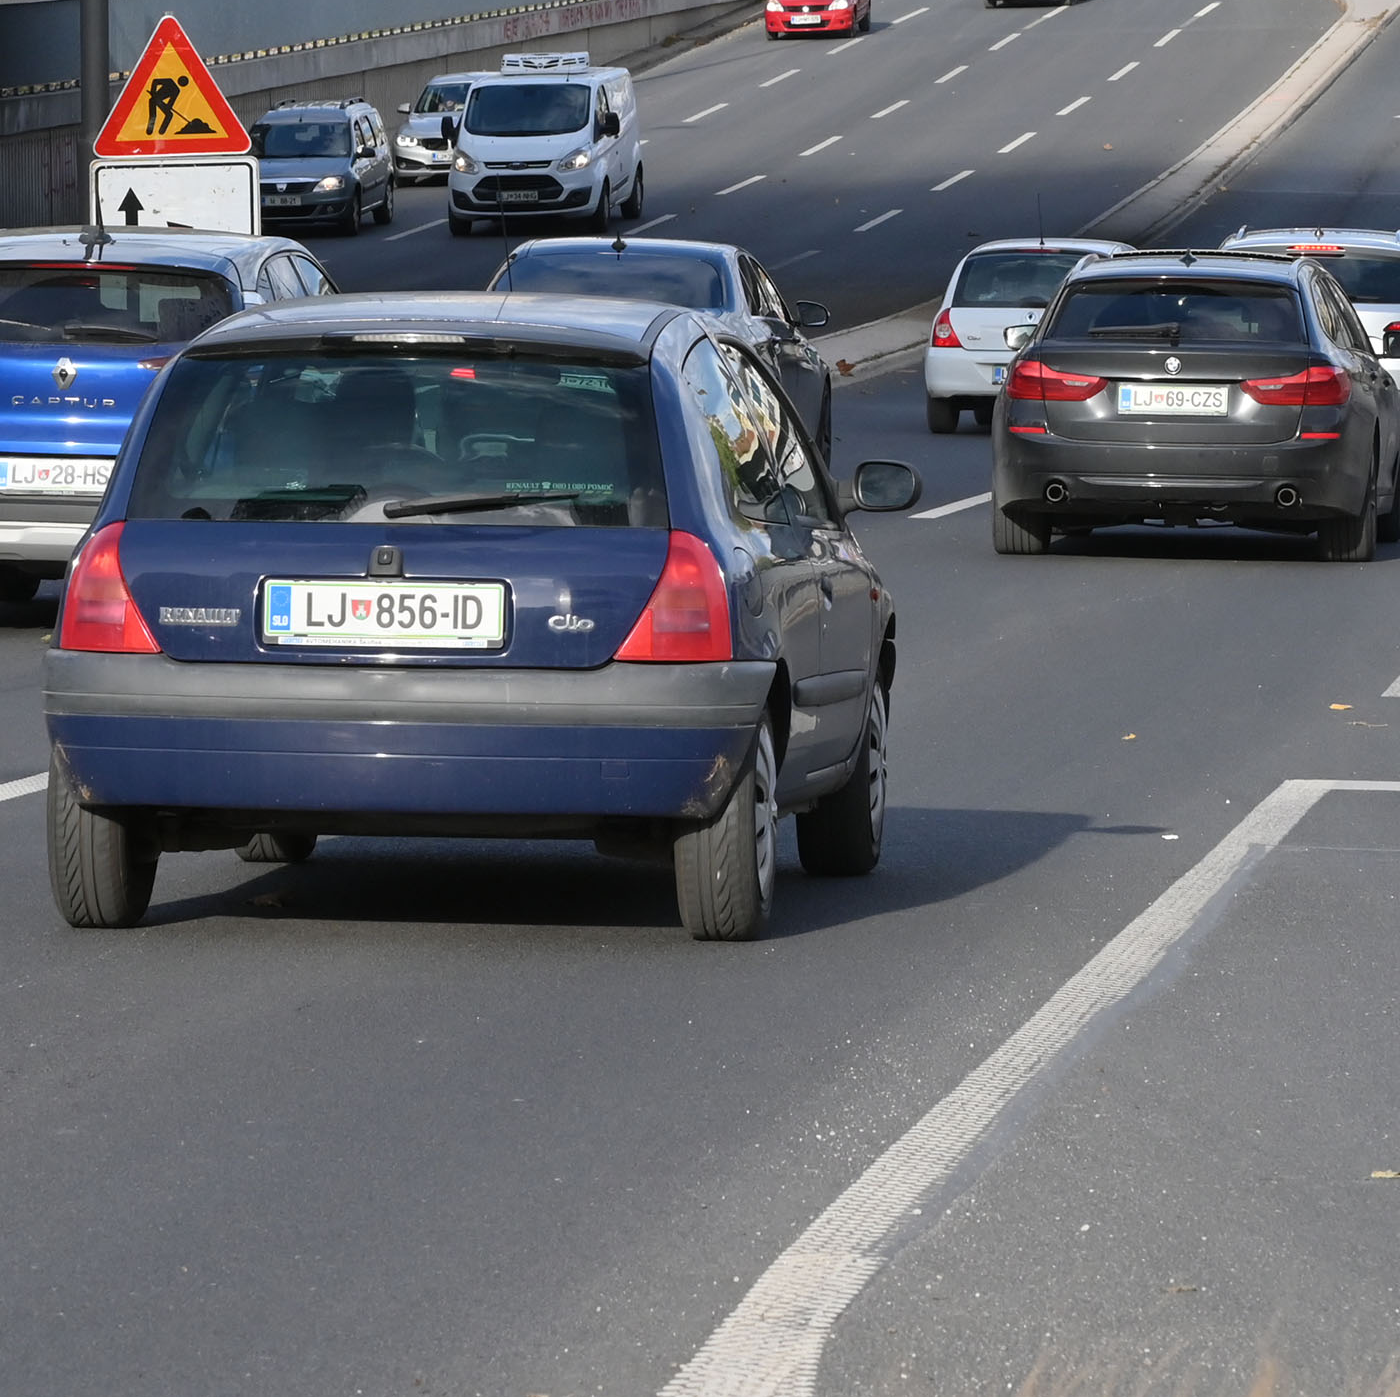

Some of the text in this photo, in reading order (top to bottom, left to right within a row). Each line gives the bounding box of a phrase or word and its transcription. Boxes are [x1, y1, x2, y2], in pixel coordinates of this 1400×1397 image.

[11, 395, 116, 408] CAPTUR
[1133, 390, 1223, 408] LJ 69-CZS
[11, 464, 113, 486] LJ 28-HS
[159, 606, 241, 626] RENAULT
[306, 591, 484, 630] LJ 856-ID
[271, 614, 289, 627] SLO
